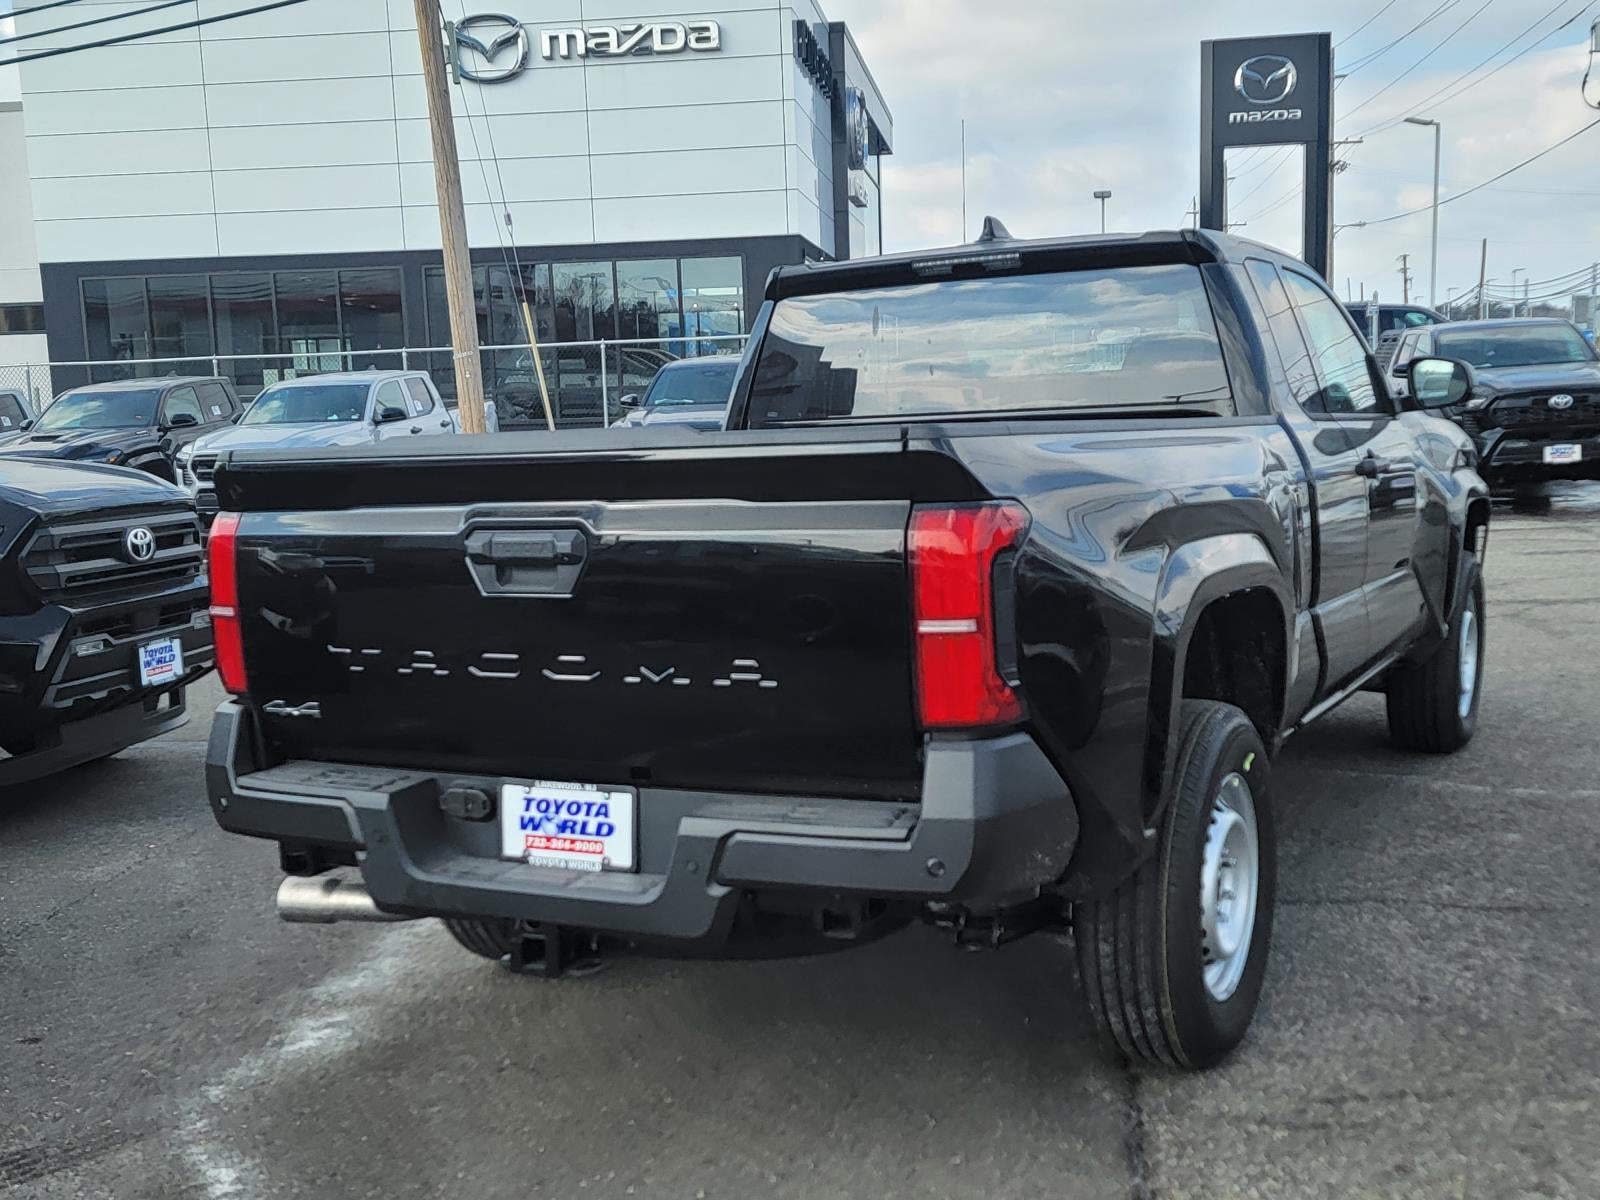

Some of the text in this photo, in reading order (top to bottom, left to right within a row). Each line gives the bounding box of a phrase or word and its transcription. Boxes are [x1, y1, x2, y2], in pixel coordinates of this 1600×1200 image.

[144, 645, 173, 658] TOYOTA
[327, 644, 778, 689] TACOMA
[523, 797, 609, 818] TOYOTA
